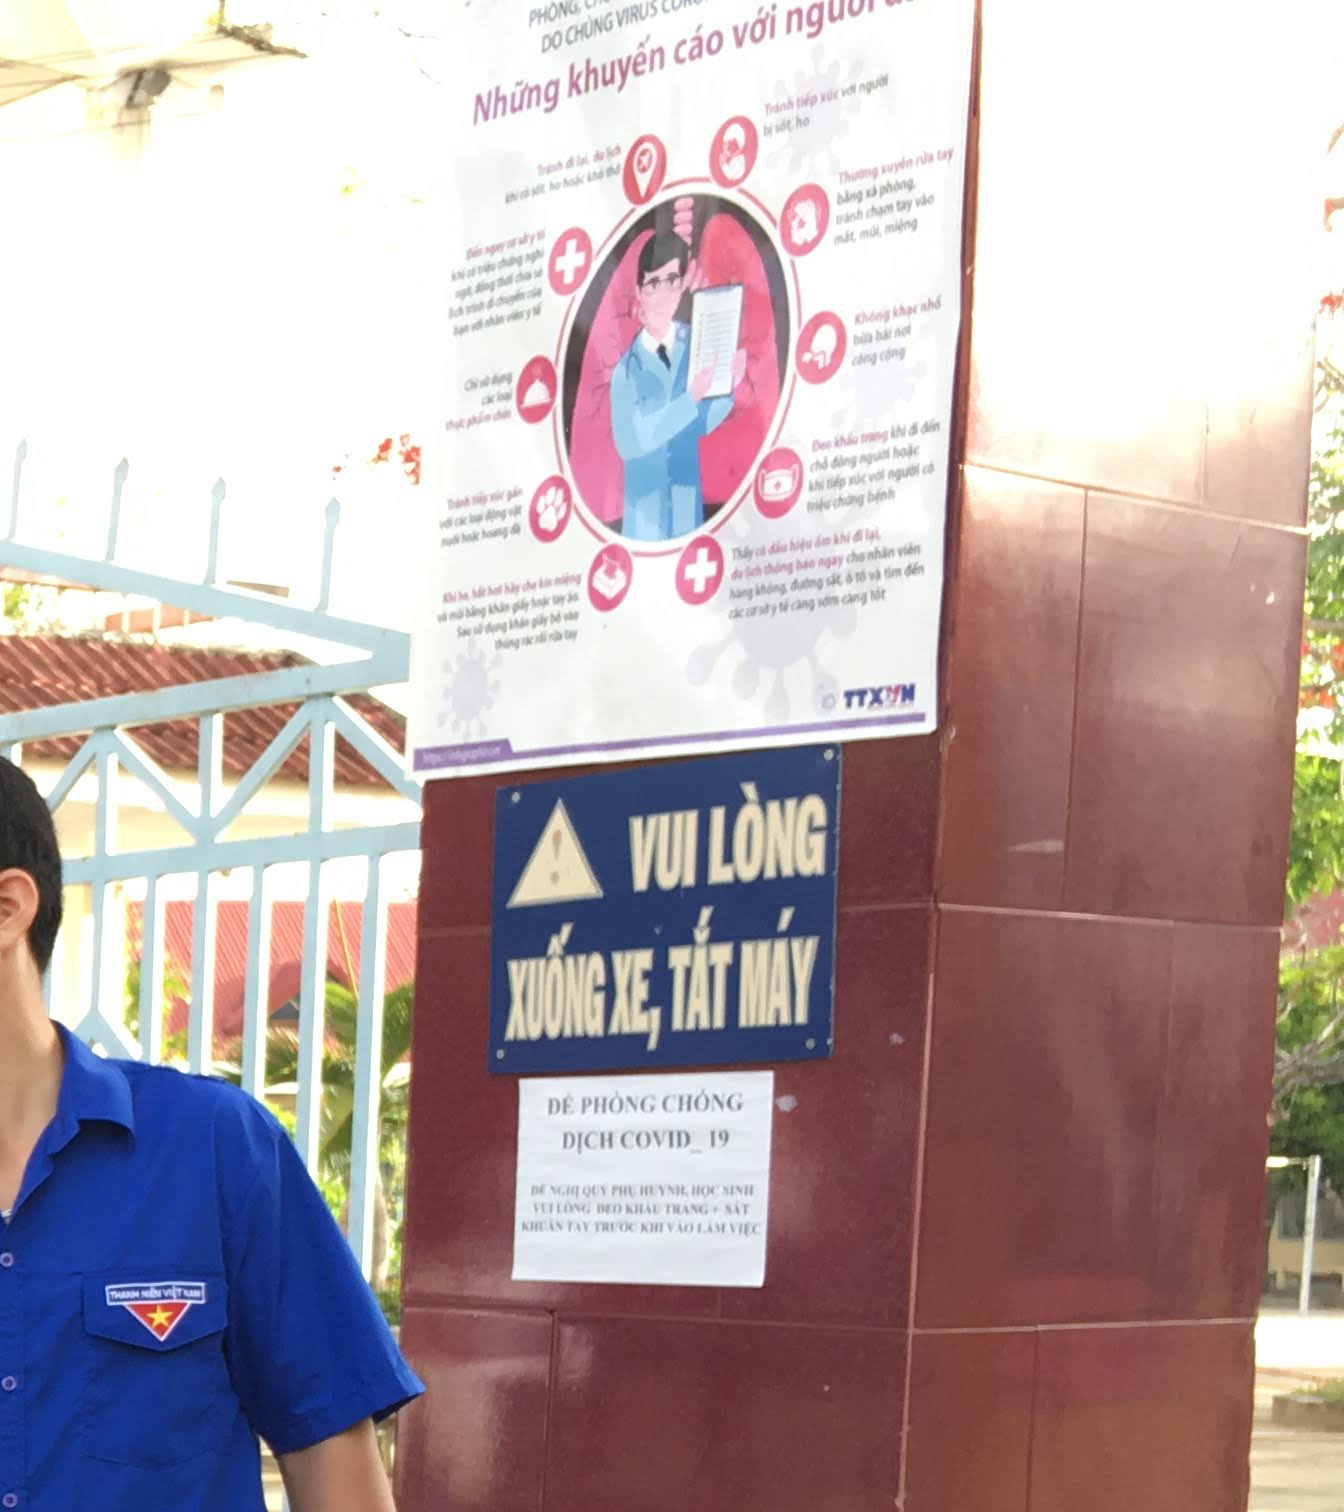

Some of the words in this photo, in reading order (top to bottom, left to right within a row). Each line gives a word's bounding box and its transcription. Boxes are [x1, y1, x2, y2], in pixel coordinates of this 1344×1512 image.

[541, 29, 562, 53] DO
[616, 0, 658, 27] VIRUS
[473, 78, 560, 125] Những
[567, 34, 665, 98] khuyến
[673, 24, 724, 65] cáo
[732, 3, 777, 49] với
[796, 116, 810, 129] ho
[937, 147, 953, 163] tay
[896, 199, 912, 213] tay
[629, 809, 699, 893] VUI
[707, 781, 828, 886] LÒNG
[505, 922, 607, 1042] XUỐNG
[668, 905, 733, 1032] TẮT
[738, 906, 820, 1029] MÁY
[580, 1090, 656, 1116] PHÒNG
[562, 1130, 612, 1154] DỊCH
[710, 1128, 730, 1149] 19
